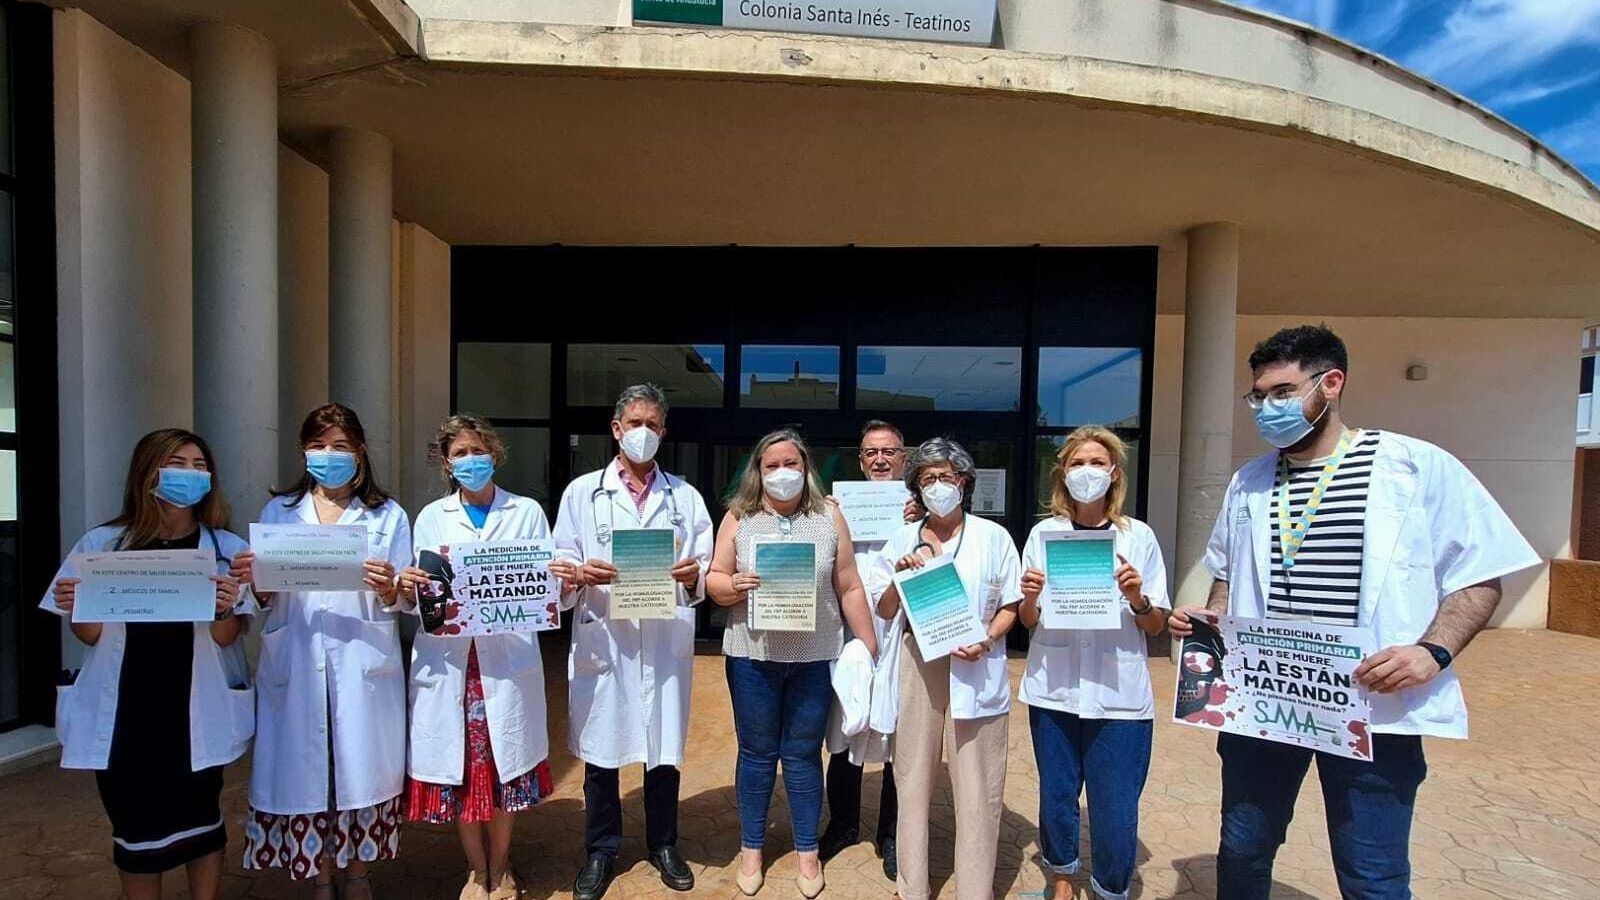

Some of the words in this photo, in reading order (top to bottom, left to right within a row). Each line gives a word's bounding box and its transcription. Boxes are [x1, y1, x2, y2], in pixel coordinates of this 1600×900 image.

[739, 0, 801, 20] Colonia
[807, 4, 852, 24] Santa
[857, 8, 891, 27] Inés
[904, 12, 971, 33] Teatinos
[466, 555, 507, 565] ATENCIÓN
[509, 553, 549, 562] PRIMARIA
[488, 546, 528, 554] MEDICINA
[468, 575, 490, 586] LA
[495, 570, 547, 584] ESTÁN
[470, 585, 551, 599] MATANDO.
[480, 604, 529, 624] SMA
[1249, 625, 1264, 633] LA
[1267, 627, 1322, 641] MEDICINA
[1325, 634, 1343, 643] DE
[1240, 634, 1295, 649] ATENCIÓN
[1296, 641, 1357, 658] PRIMARIA
[1258, 647, 1273, 657] NO
[1276, 650, 1290, 659] SE
[1293, 652, 1335, 668] MUERE,
[1243, 657, 1271, 674] LA
[1276, 661, 1351, 688] ESTÁN
[1244, 673, 1356, 708] MATANDO.
[1254, 700, 1320, 736] SMA
